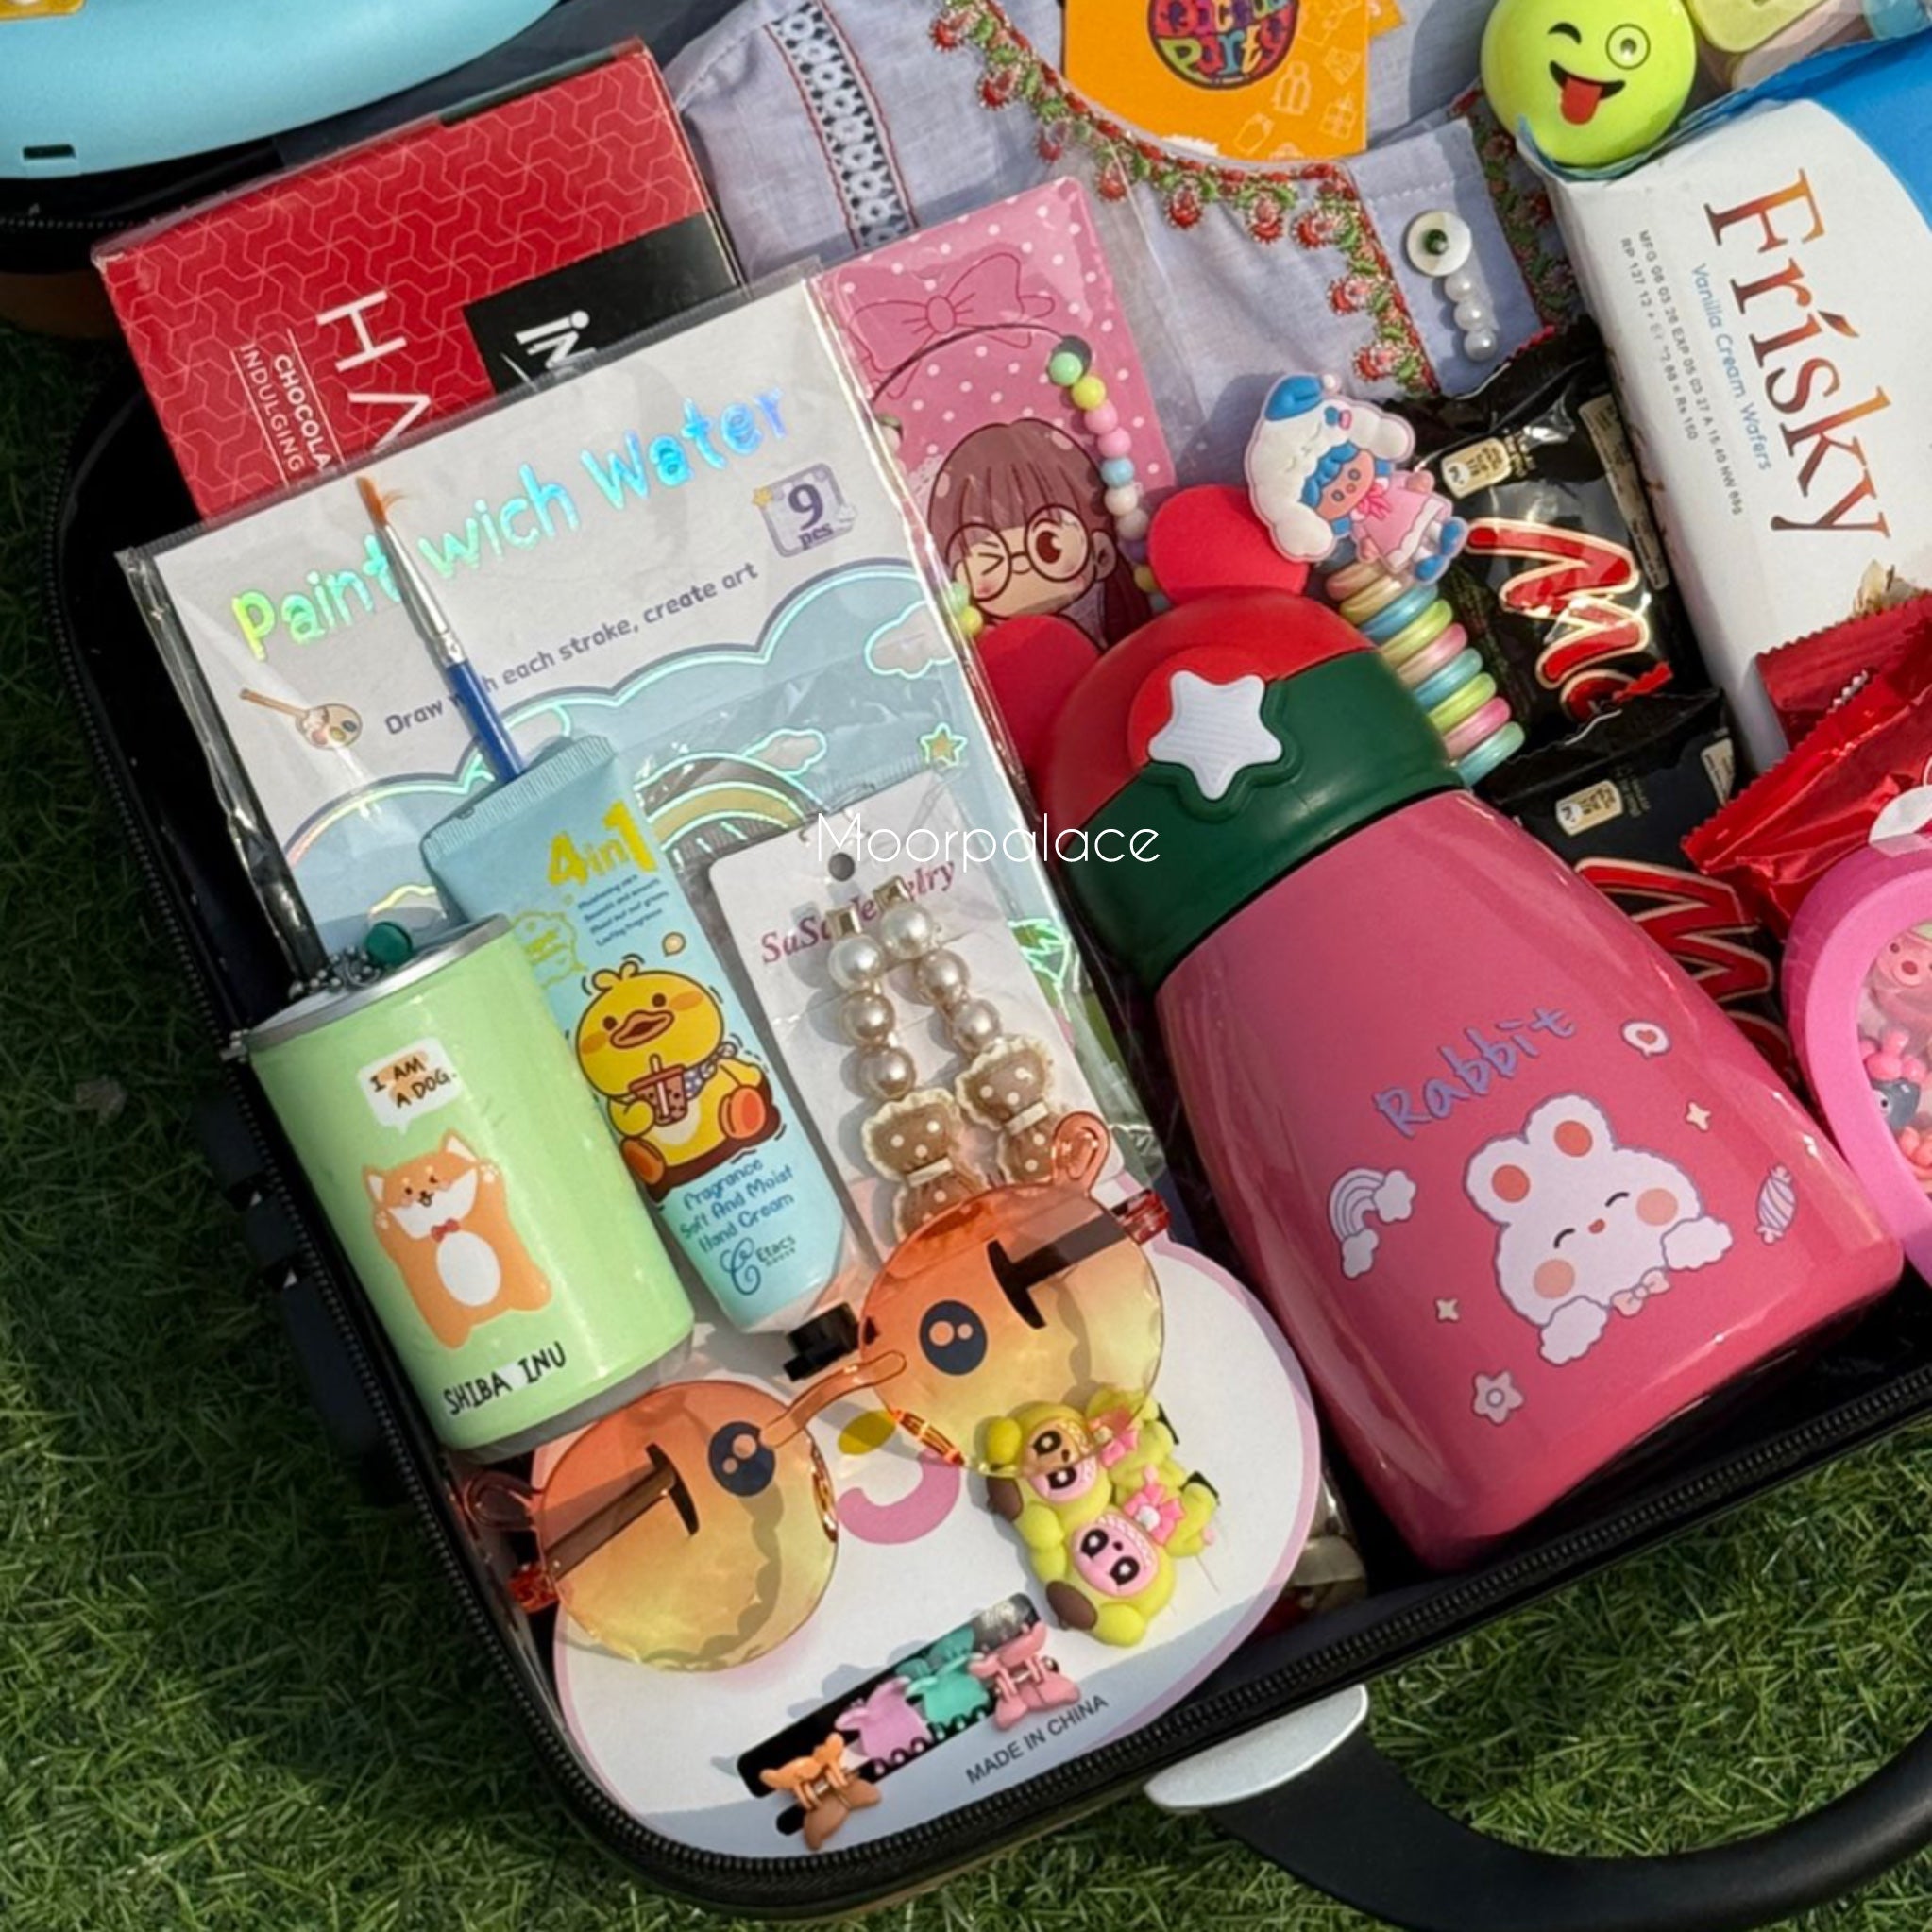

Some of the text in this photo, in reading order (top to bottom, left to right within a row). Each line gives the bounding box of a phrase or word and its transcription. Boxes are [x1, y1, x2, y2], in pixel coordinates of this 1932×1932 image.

[1671, 327, 1690, 355] EXP
[1691, 263, 1772, 471] Vanilla Cream Wafers
[240, 343, 306, 472] INDULGING
[230, 386, 788, 662] Paint wich Water
[788, 483, 824, 531] 9
[798, 522, 834, 551] pcs
[384, 699, 444, 735] Draw
[502, 651, 556, 686] each
[557, 617, 640, 662] stroke,
[643, 579, 719, 626] create
[721, 562, 759, 590] art
[547, 800, 659, 888] 4in1
[370, 1056, 427, 1093] I AM
[397, 1067, 458, 1109] A DOG.
[1371, 1007, 1577, 1140] Rabbit
[679, 1164, 795, 1239] Soft And Moist
[683, 1158, 764, 1211] Fragrance
[698, 1193, 796, 1253] Hand Cream
[442, 1340, 567, 1415] SHIBA INU
[965, 1694, 1110, 1785] MADE IN CHINA
